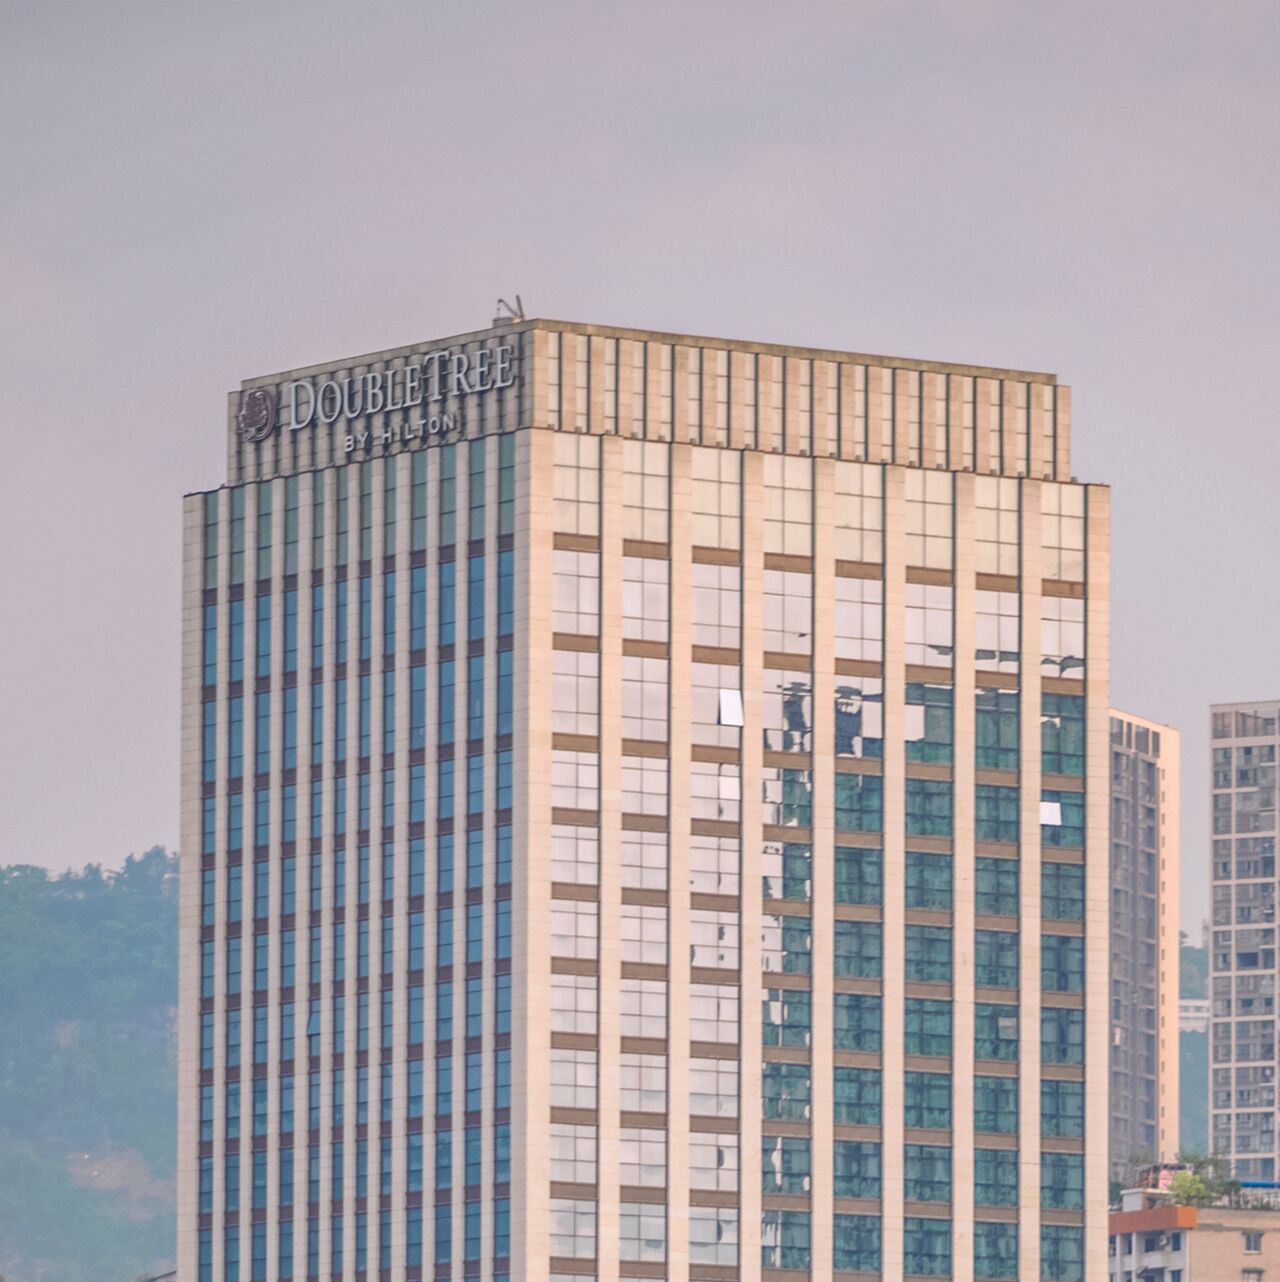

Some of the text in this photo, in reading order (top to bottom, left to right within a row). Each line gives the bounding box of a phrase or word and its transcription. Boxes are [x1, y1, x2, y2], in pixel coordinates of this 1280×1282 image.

[288, 345, 515, 431] DOUBLETREE
[344, 414, 456, 453] BY HILTON
